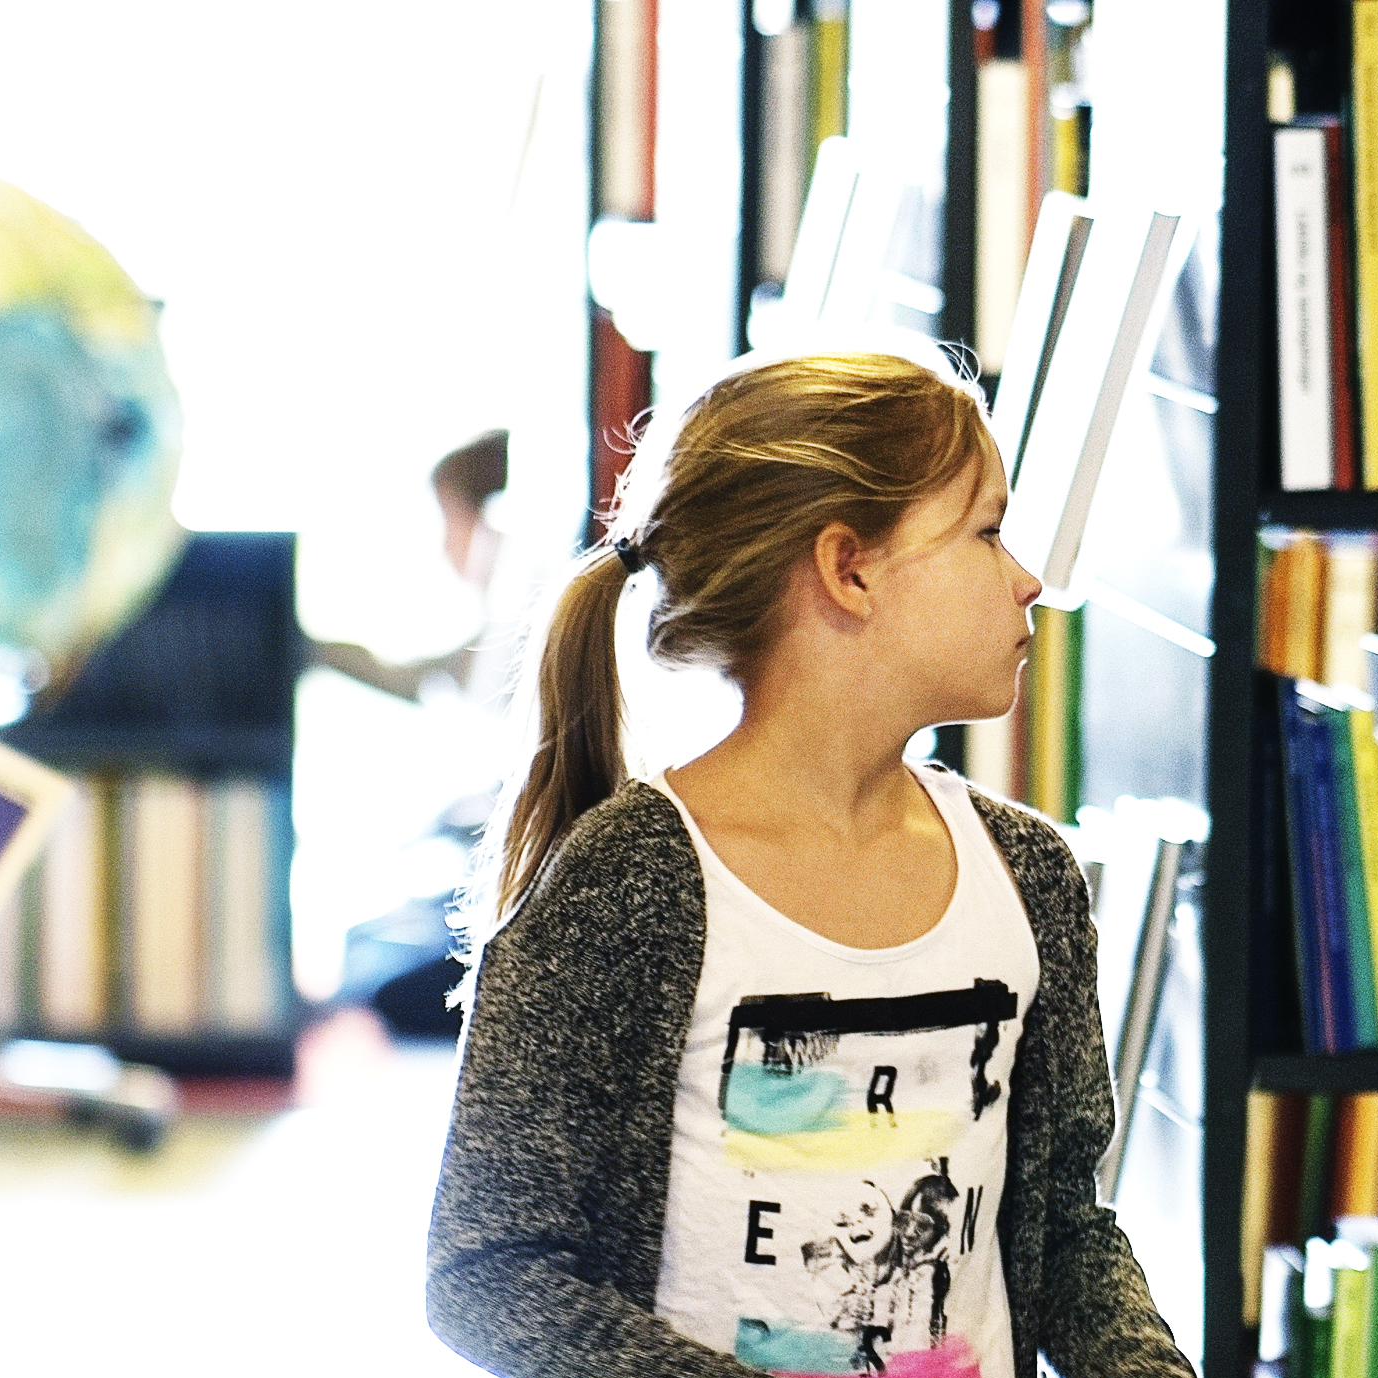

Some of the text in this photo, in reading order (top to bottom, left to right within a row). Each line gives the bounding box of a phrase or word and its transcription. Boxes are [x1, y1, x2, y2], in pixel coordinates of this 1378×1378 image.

[866, 1065, 898, 1128] R
[743, 1184, 983, 1266] E N
